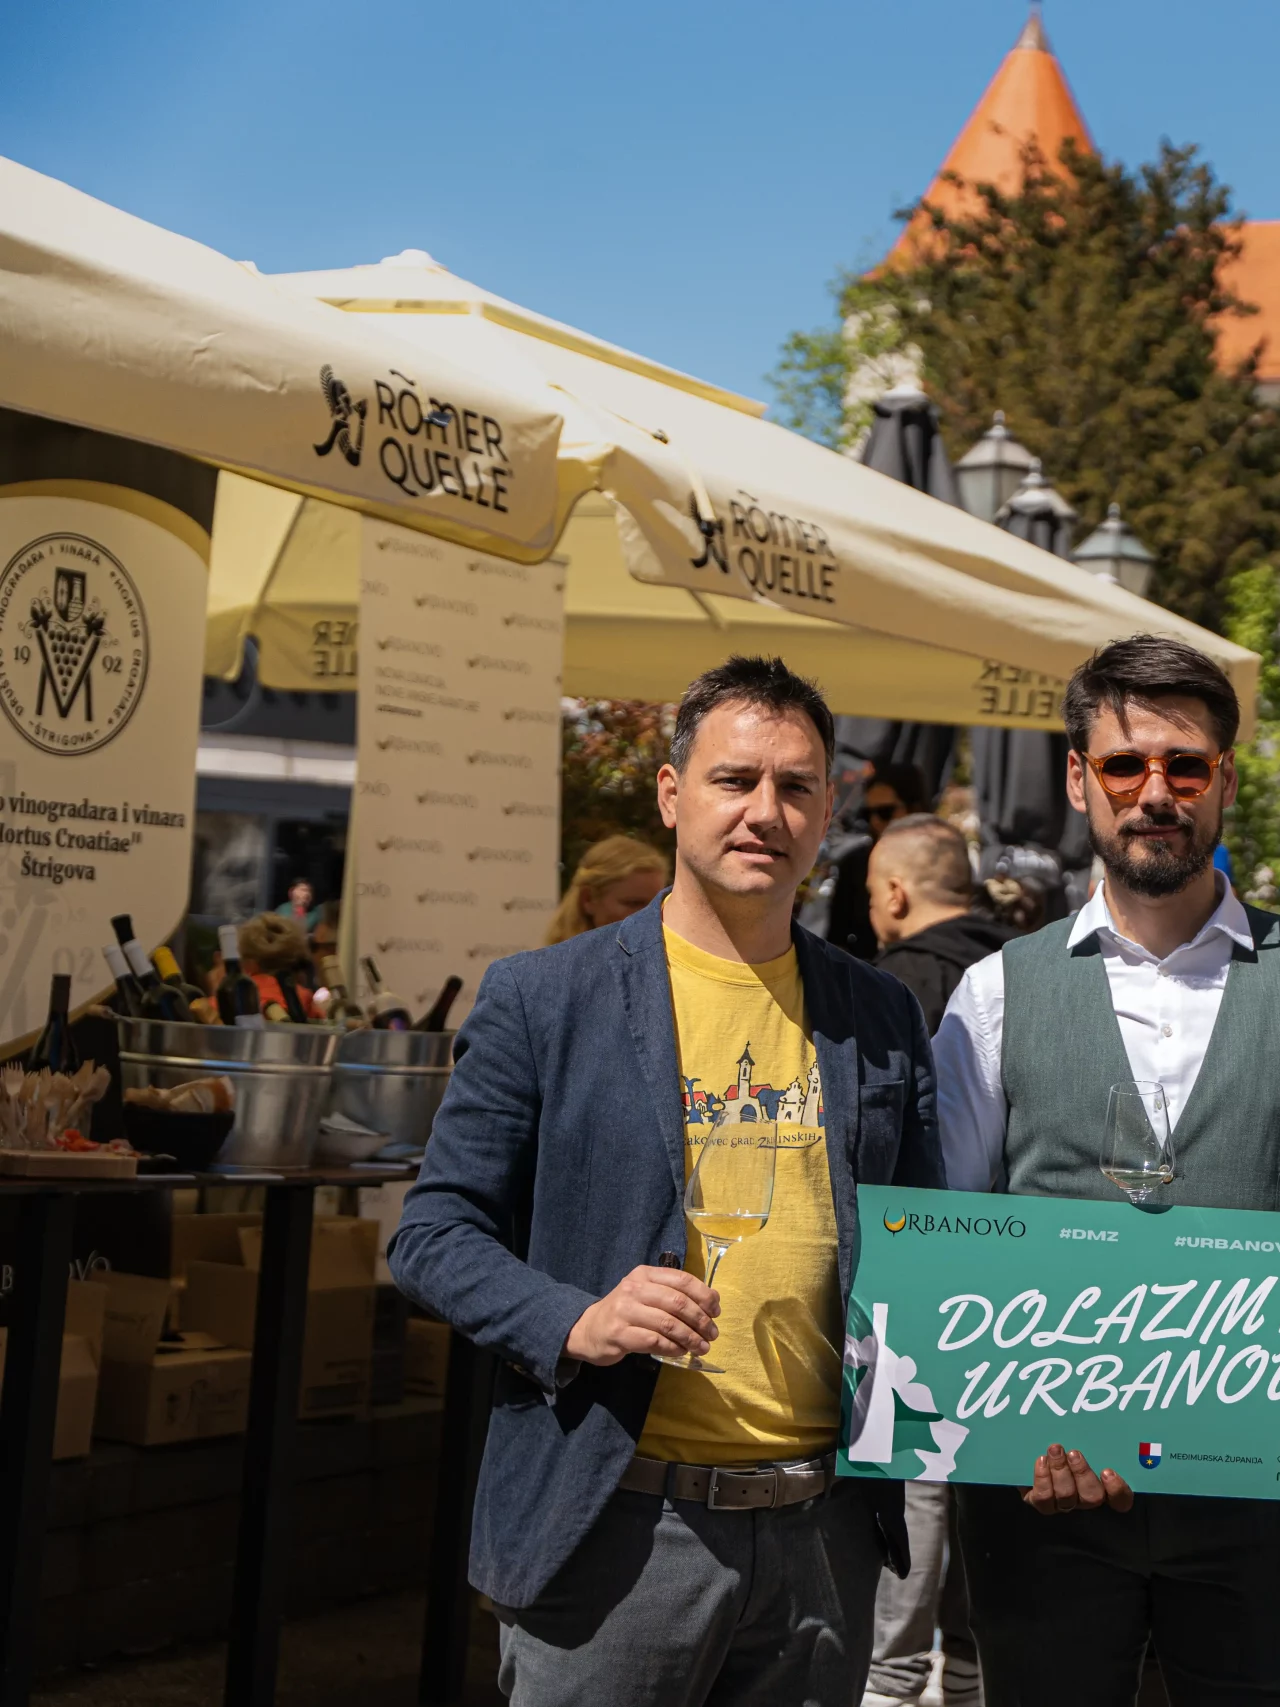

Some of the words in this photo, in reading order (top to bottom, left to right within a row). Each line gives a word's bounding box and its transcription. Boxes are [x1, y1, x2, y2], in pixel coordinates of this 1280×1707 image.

[379, 436, 509, 514] QUELLE
[59, 544, 101, 566] VINARA
[738, 546, 837, 604] QUELLE
[13, 645, 31, 665] 19
[102, 655, 123, 673] 92
[8, 791, 117, 823] vinogradara
[121, 802, 128, 823] i
[132, 804, 186, 828] vinara
[20, 851, 96, 884] Štrigova
[882, 1205, 1026, 1238] URBANOVO
[1059, 1227, 1119, 1243] #DMZ
[937, 1275, 1279, 1351] DOLAZIM
[1169, 1452, 1224, 1463] MEĐIMURSKA
[1225, 1454, 1264, 1465] ŽUPANIJA
